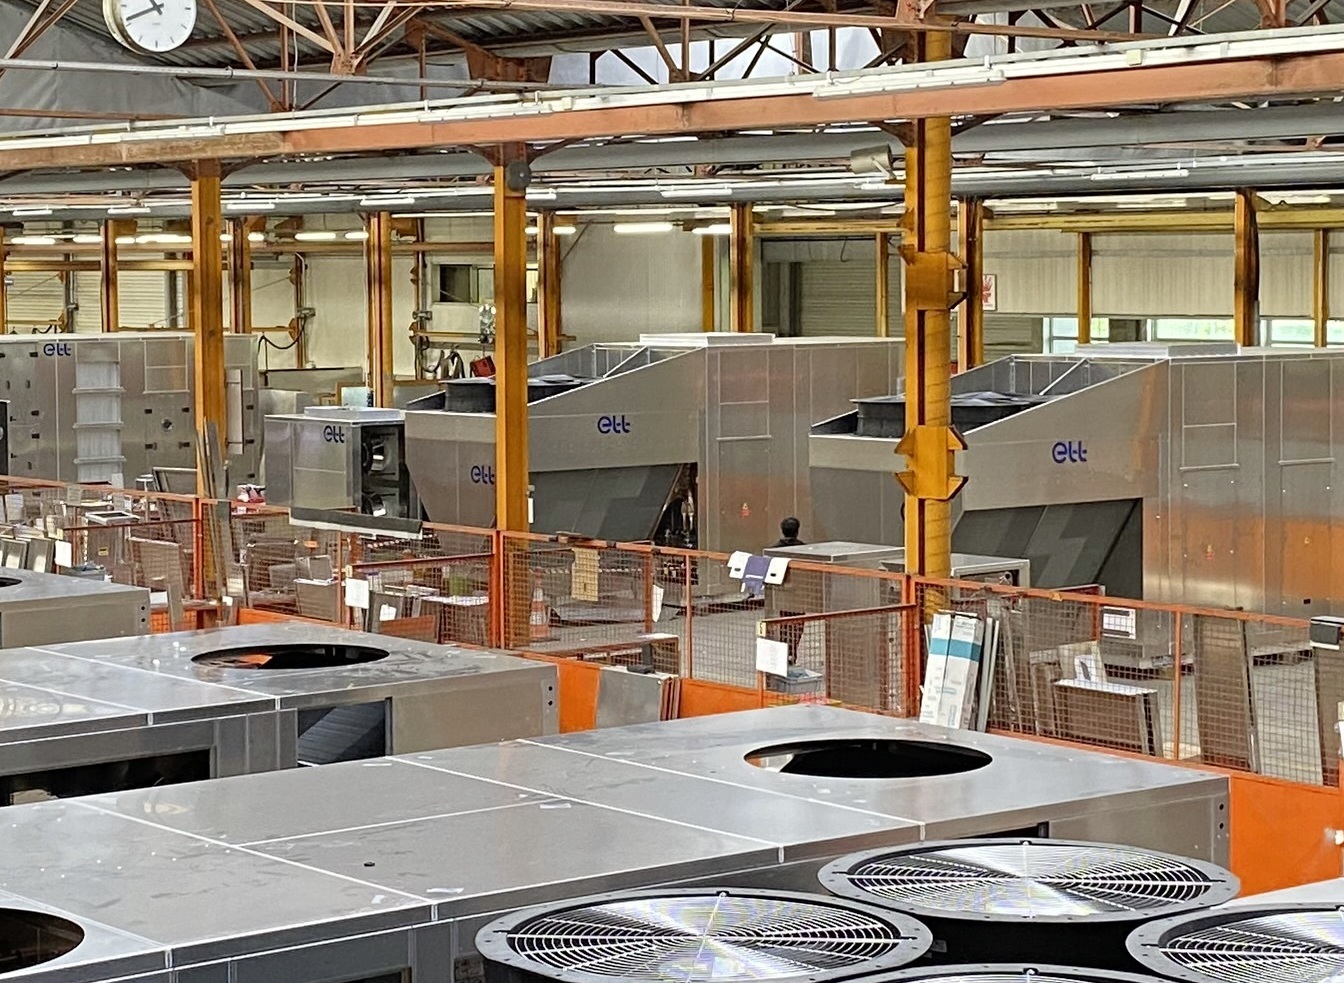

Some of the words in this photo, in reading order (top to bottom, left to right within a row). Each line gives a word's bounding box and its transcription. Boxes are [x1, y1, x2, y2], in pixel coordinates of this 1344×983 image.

[43, 343, 71, 356] ett
[597, 415, 630, 434] ett
[323, 425, 345, 443] ett
[1052, 440, 1088, 464] ett
